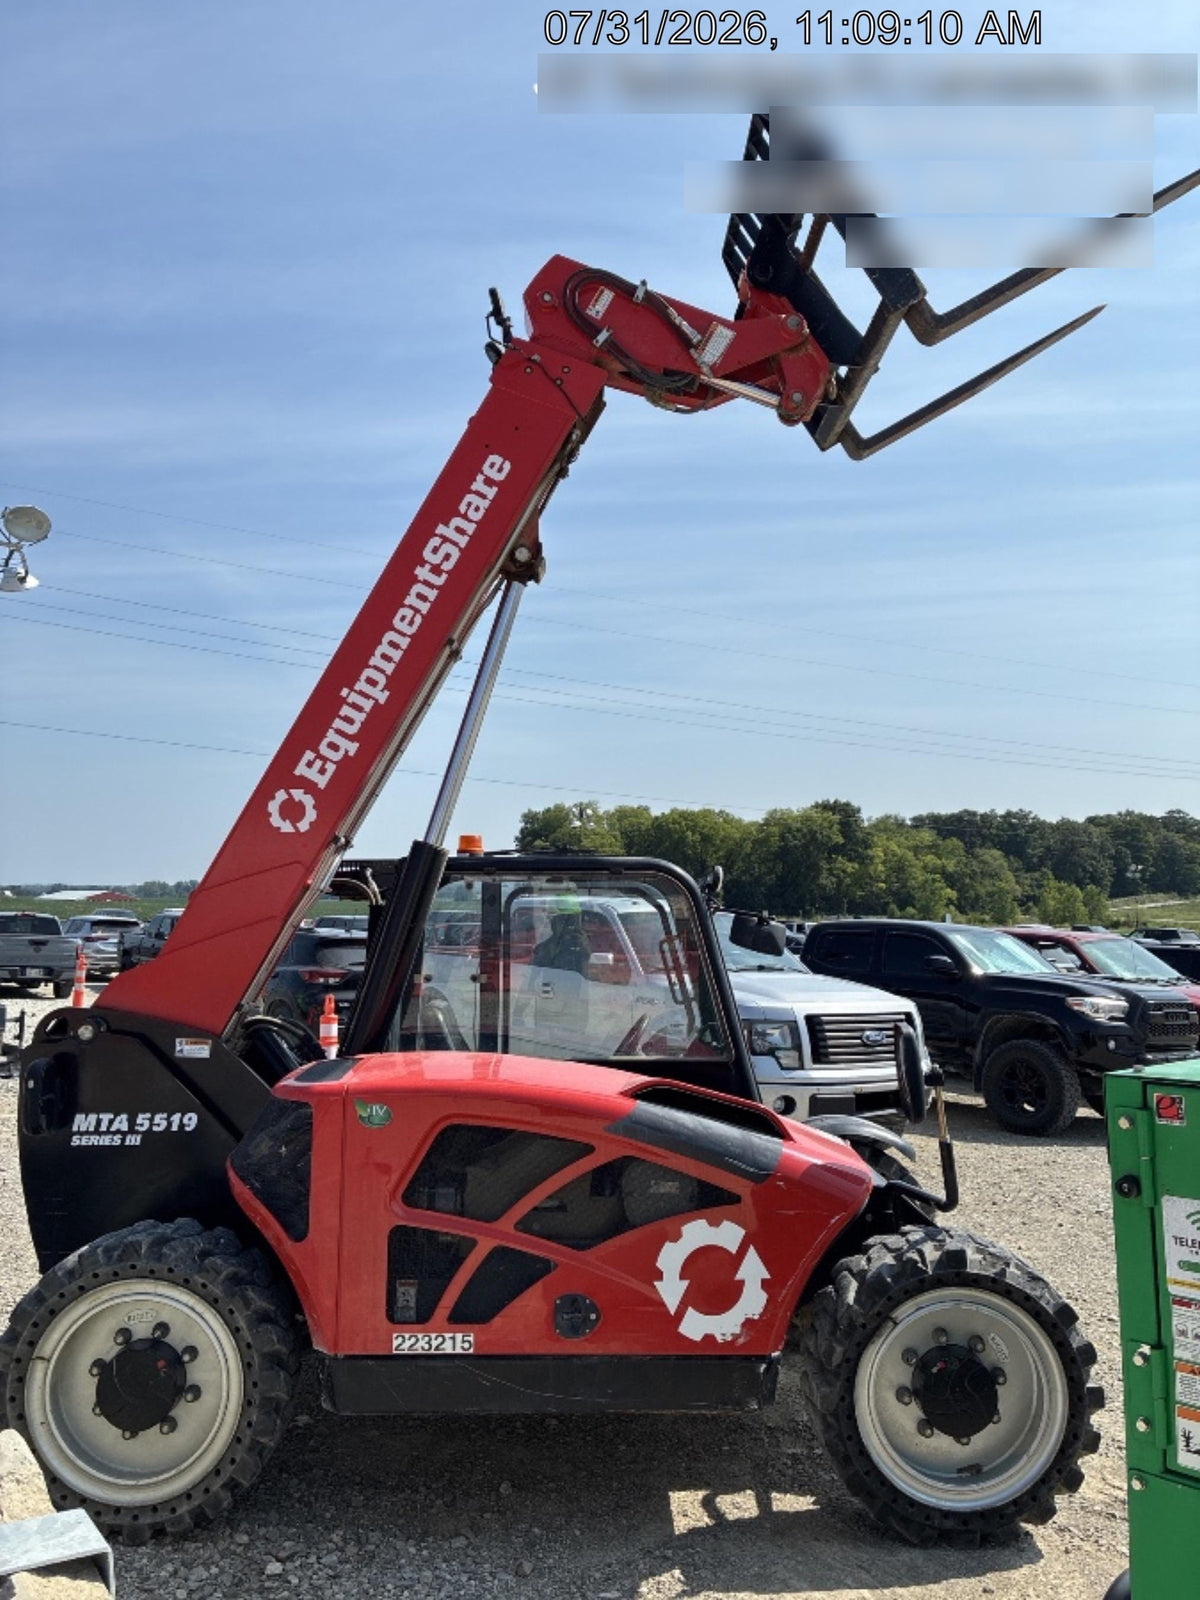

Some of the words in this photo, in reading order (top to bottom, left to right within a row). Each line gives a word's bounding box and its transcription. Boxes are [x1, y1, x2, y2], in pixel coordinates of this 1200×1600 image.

[293, 453, 512, 790] EquipmentShare
[72, 1113, 129, 1132] MTA
[134, 1112, 199, 1132] 5519
[70, 1134, 123, 1146] SERIES
[124, 1133, 143, 1146] III
[1171, 1235, 1200, 1250] TELE
[394, 1334, 473, 1352] 223215
